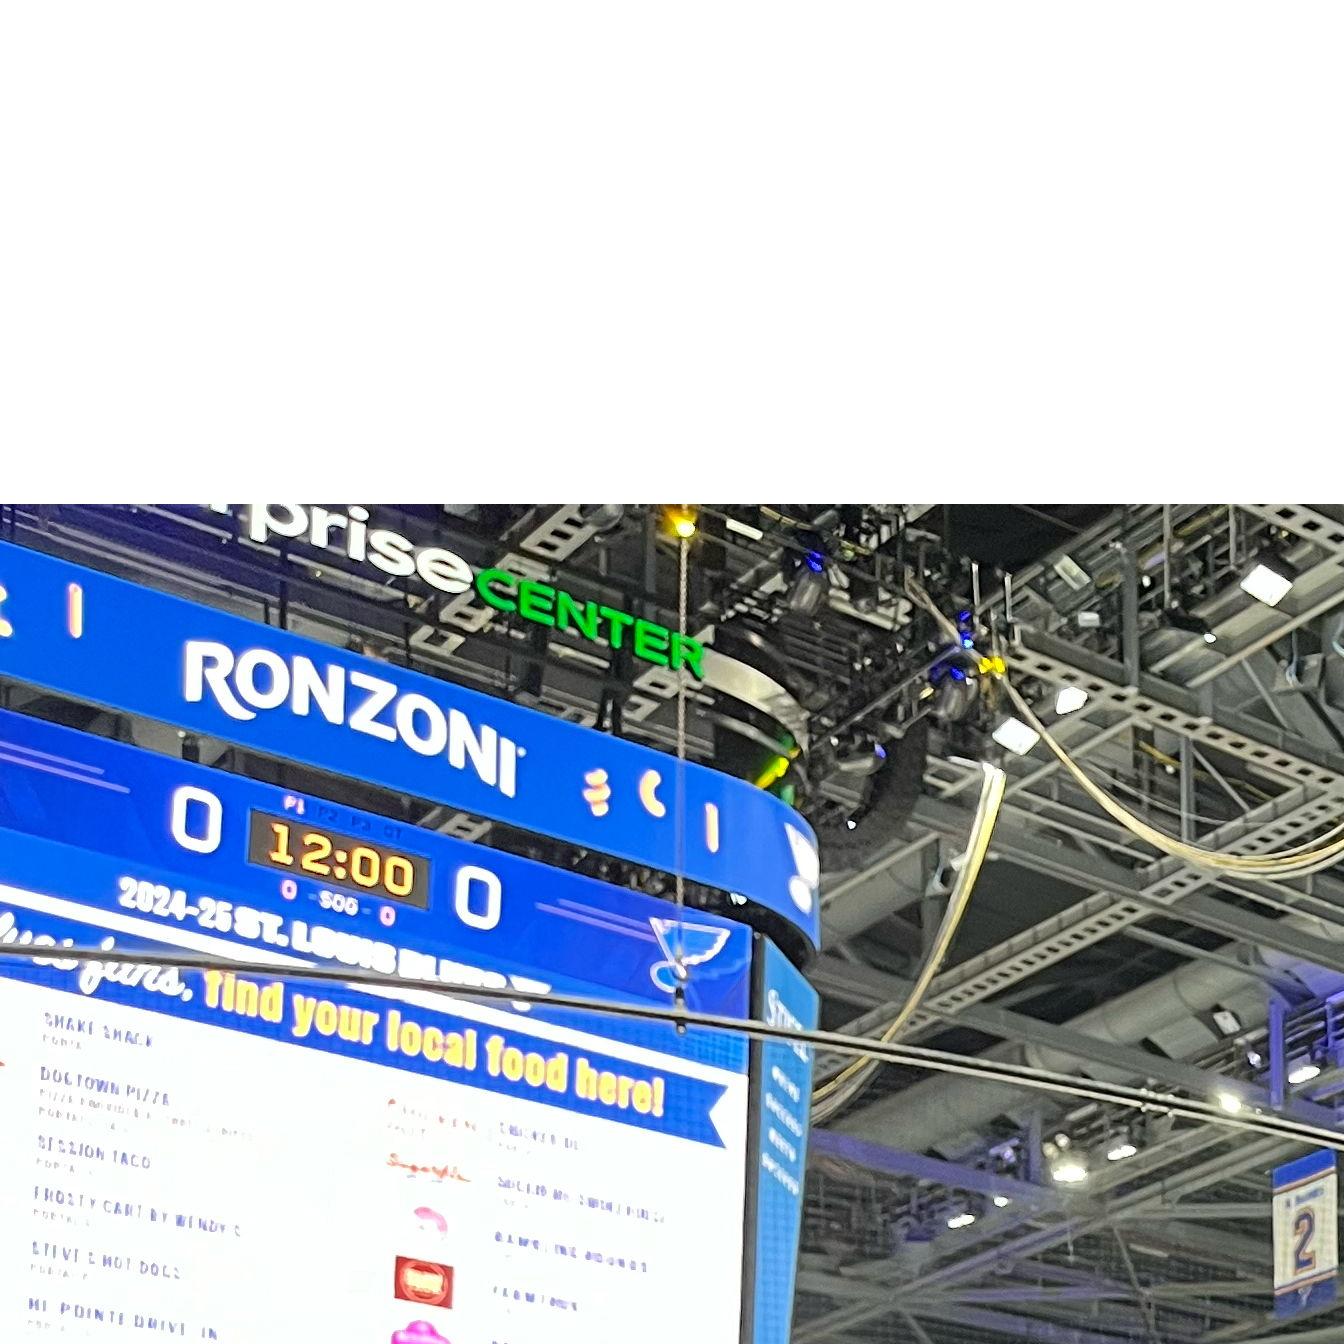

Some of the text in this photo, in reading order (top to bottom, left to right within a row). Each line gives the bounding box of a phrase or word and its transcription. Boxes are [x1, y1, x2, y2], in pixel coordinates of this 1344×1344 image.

[475, 568, 705, 679] CENTER
[182, 640, 518, 799] RONZONI
[171, 786, 223, 854] 0
[267, 822, 414, 897] 12:00
[118, 877, 234, 932] 2024-25
[455, 864, 502, 931] 0
[204, 967, 285, 1023] find
[292, 994, 380, 1046] your
[386, 1011, 477, 1070] local
[487, 1031, 567, 1093] food
[575, 1058, 666, 1118] here!
[1293, 1206, 1317, 1276] 2
